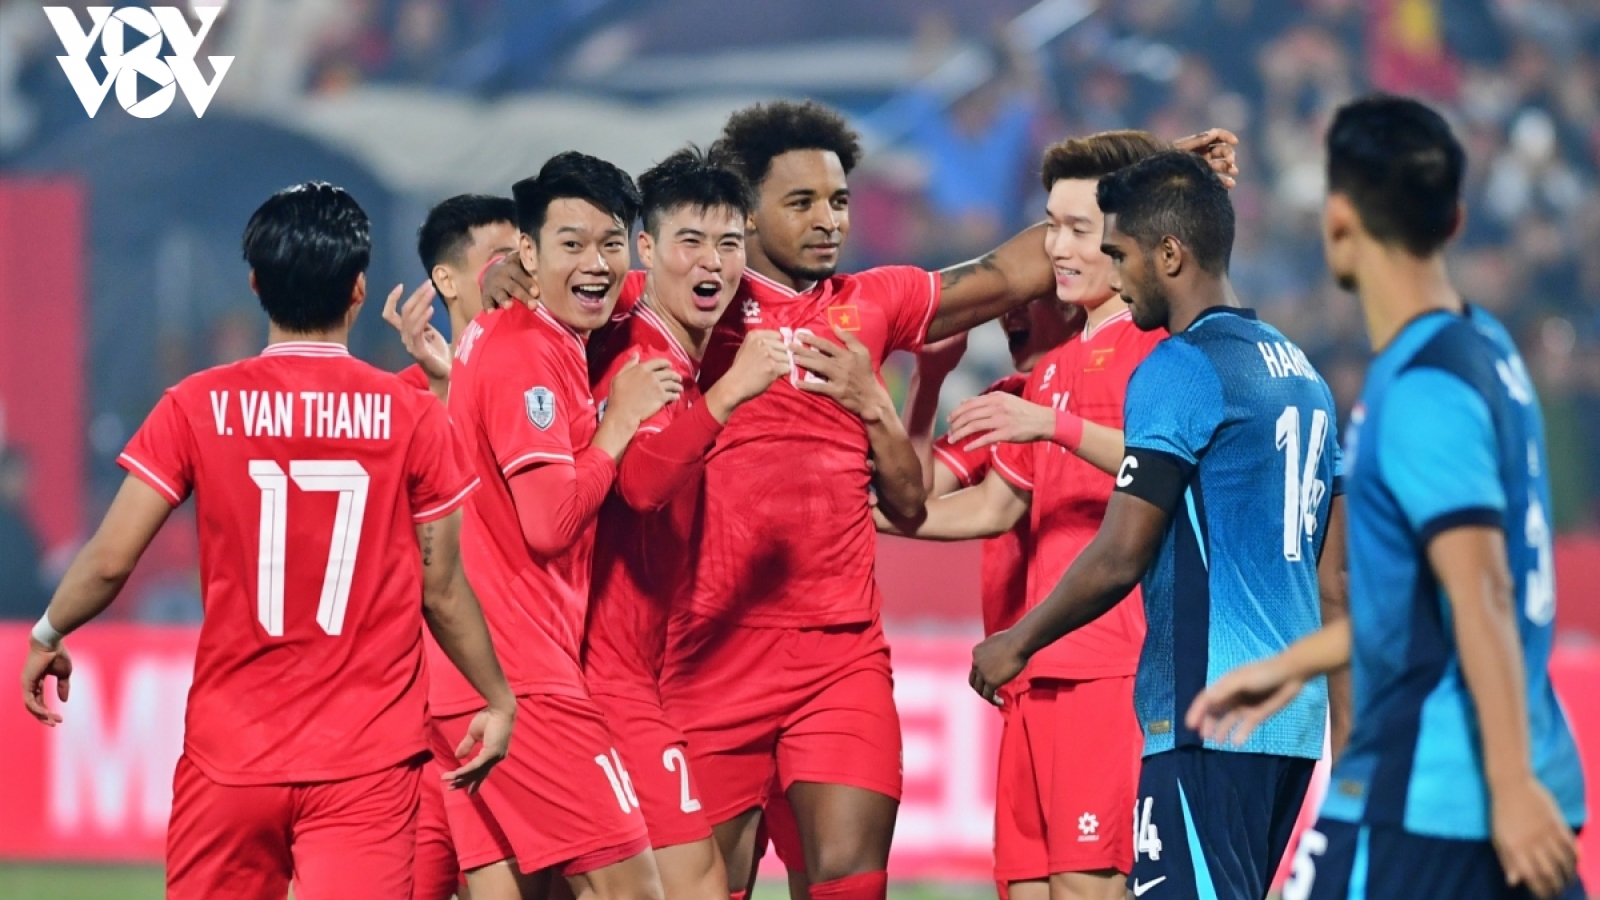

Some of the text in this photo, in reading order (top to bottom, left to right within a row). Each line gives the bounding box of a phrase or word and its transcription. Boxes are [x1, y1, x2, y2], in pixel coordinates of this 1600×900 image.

[210, 390, 391, 439] V. VAN THANH
[1116, 455, 1139, 488] C
[248, 459, 370, 636] 17
[50, 655, 193, 838] M
[662, 748, 701, 813] 2
